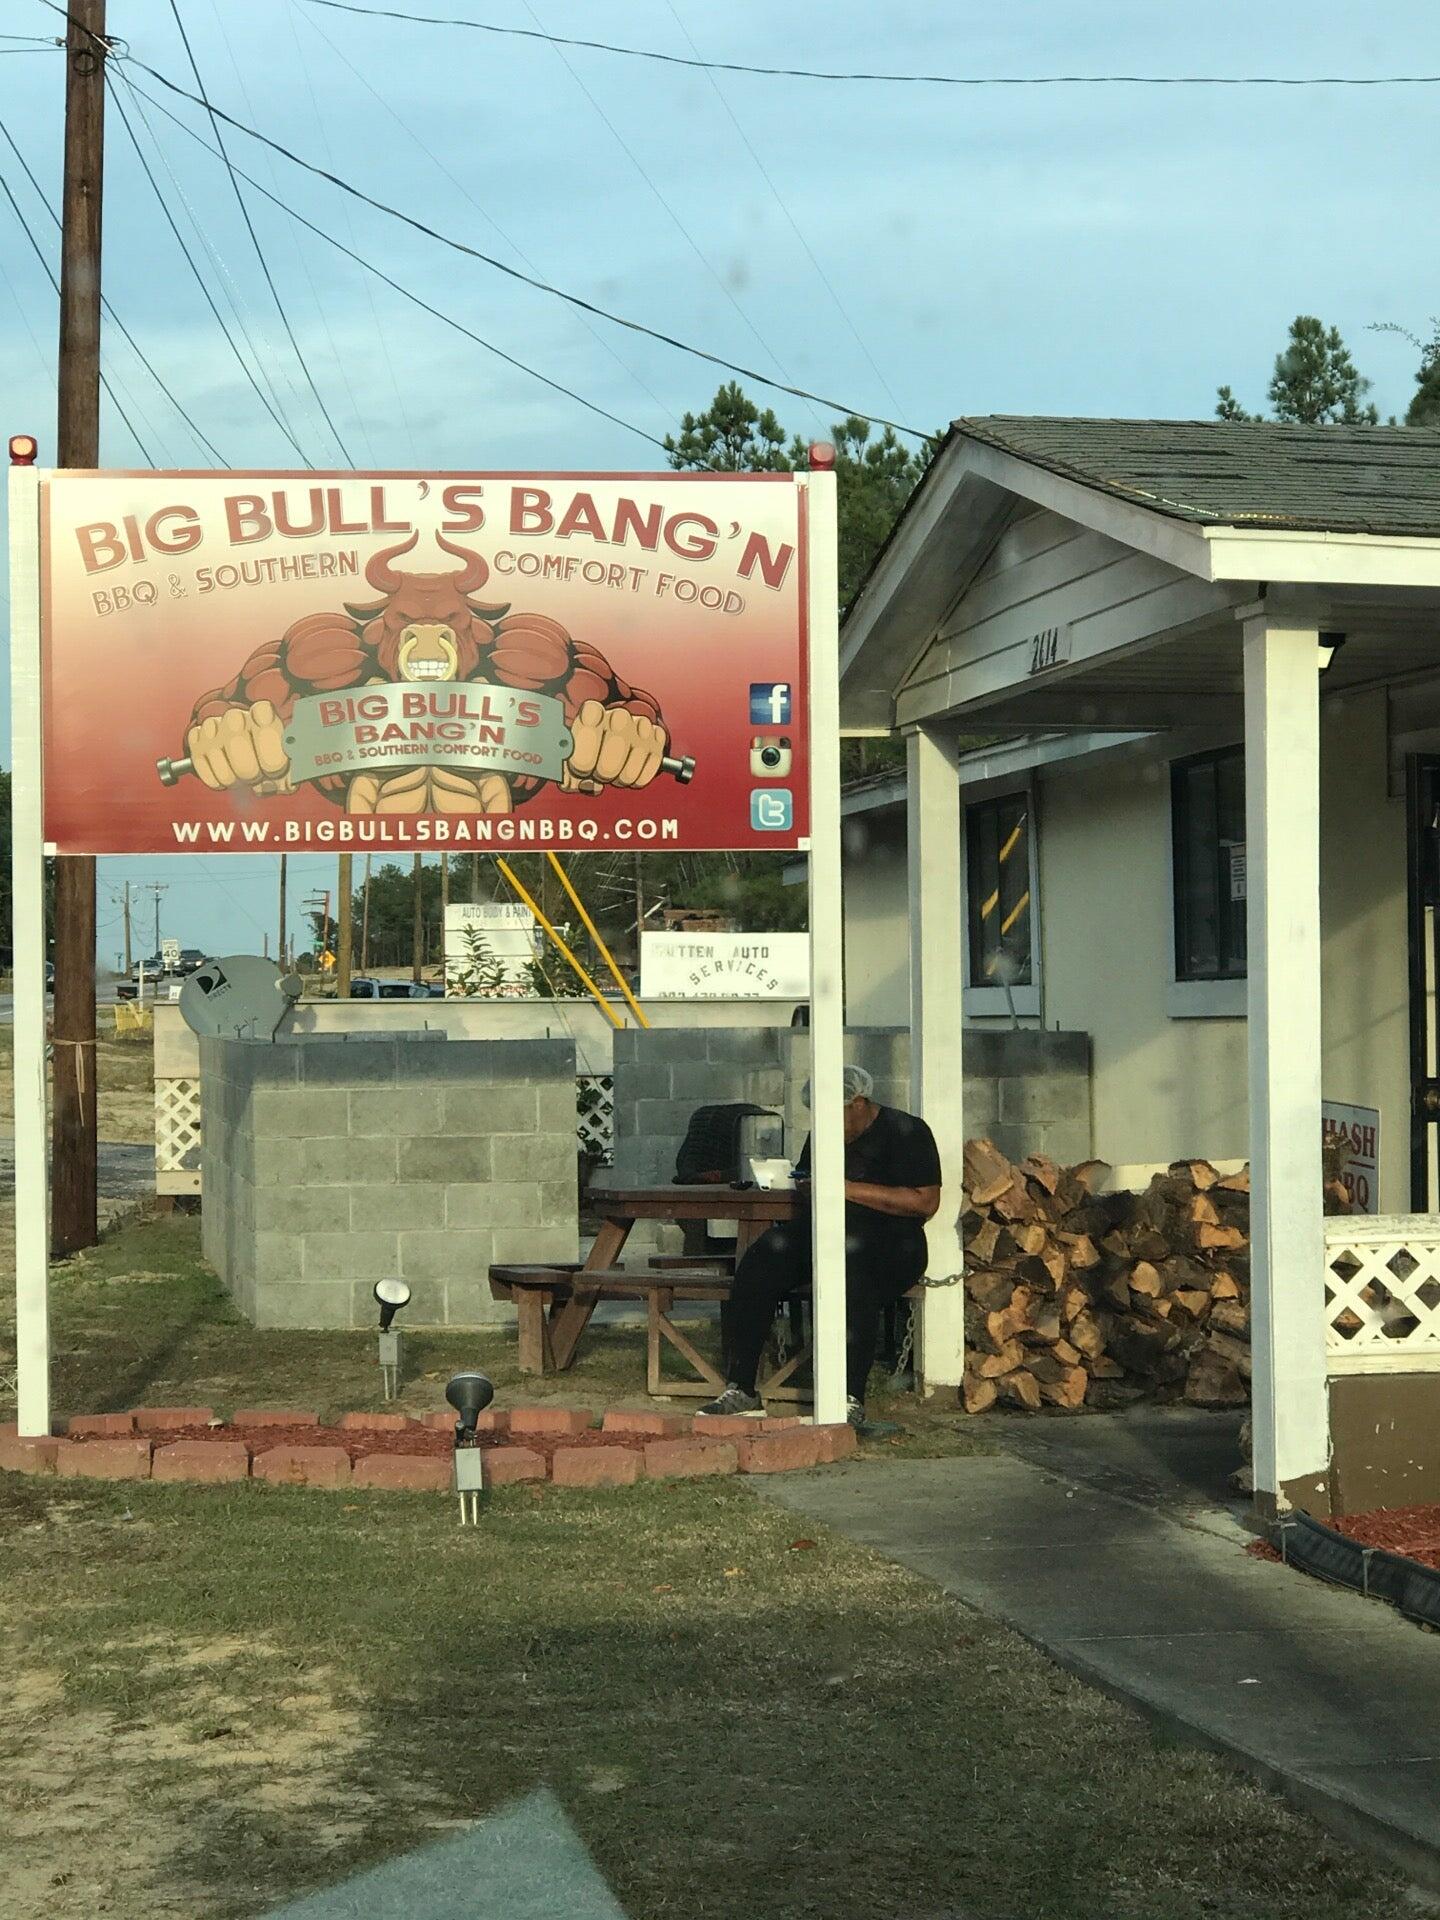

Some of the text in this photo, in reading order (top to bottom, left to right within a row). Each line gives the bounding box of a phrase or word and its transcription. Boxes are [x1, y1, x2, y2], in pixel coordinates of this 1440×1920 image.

[75, 480, 796, 592] BIG BULL'S BANG'N
[91, 549, 747, 617] BBQ & SOUTHERN COMFORT FOOD
[318, 692, 542, 728] BIG BULL'S
[354, 722, 506, 746] BANG'N
[314, 751, 343, 766] BBQ
[358, 743, 429, 759] SOUTHERN
[433, 743, 500, 757] COMFORT
[502, 747, 544, 765] FOOD
[172, 818, 680, 843] WWW.BIGBULLSBANGNBBQ.COM
[462, 906, 481, 919] AUTO
[163, 949, 177, 958] 40
[732, 946, 770, 959] AUTO
[689, 960, 780, 991] SERVICES
